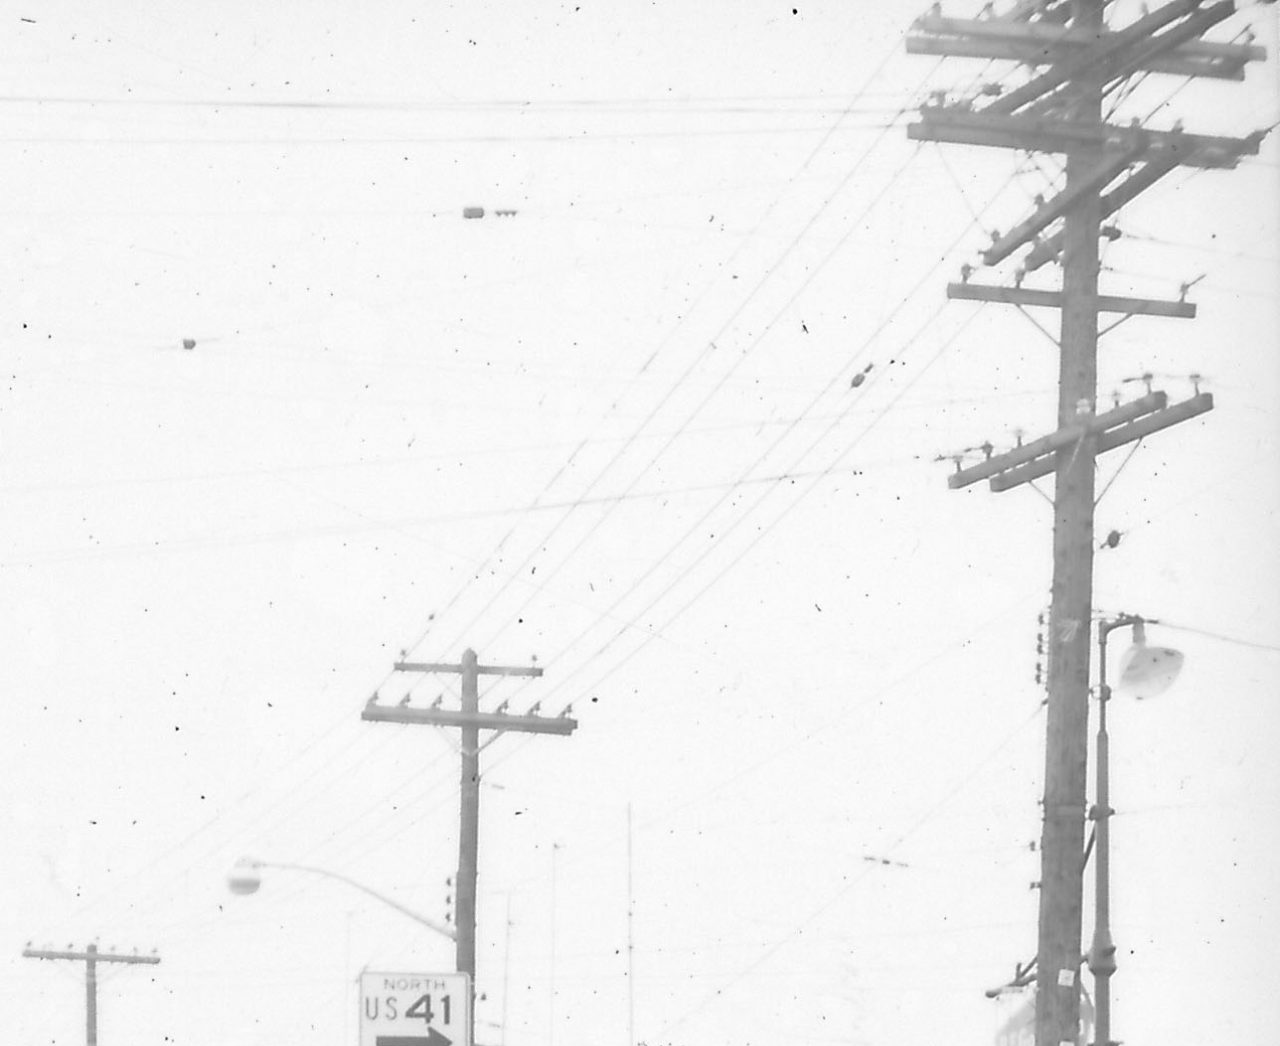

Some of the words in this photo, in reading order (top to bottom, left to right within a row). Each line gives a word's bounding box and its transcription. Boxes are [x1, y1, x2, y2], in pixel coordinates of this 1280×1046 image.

[383, 978, 446, 991] NORTH
[365, 995, 398, 1020] US
[404, 993, 451, 1025] 41
